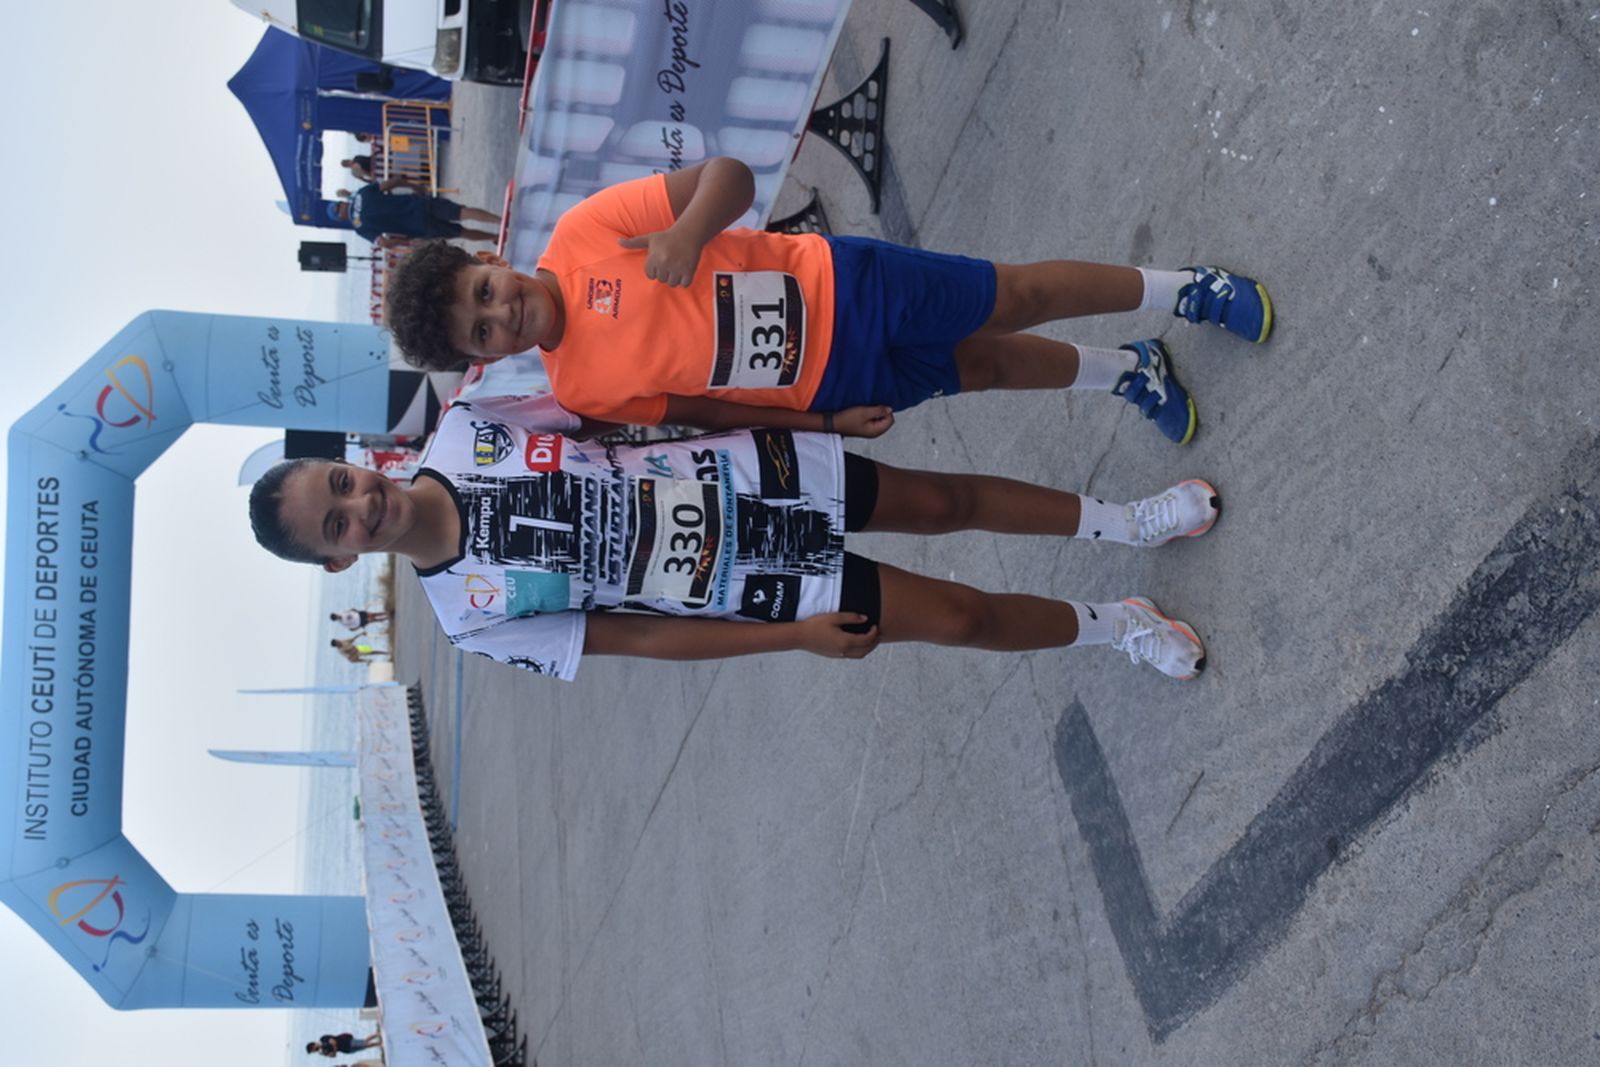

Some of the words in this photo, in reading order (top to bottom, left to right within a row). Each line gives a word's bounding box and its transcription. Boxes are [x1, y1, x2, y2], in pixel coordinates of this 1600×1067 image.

[657, 0, 701, 94] Deporte
[669, 99, 685, 123] es
[652, 127, 684, 174] euta
[586, 277, 595, 310] UNDER
[612, 279, 622, 320] ARMOUR
[266, 326, 280, 341] es
[749, 297, 785, 370] 331
[257, 345, 284, 410] Ceuta
[294, 326, 327, 408] Deporte
[35, 477, 60, 601] DEPORTES
[79, 500, 99, 570] CEUTA
[476, 496, 494, 549] Kempa
[509, 514, 575, 533] 1
[663, 503, 704, 576] 330
[724, 523, 733, 538] DE
[79, 575, 97, 604] DE
[716, 541, 734, 606] MATERIALES
[34, 608, 56, 639] DE
[28, 645, 56, 714] CEUTÍ
[72, 609, 97, 731] AUTÓNOMA
[23, 721, 53, 841] INSTITUTO
[70, 736, 92, 817] CIUDAD
[245, 918, 260, 941] es
[271, 917, 305, 1002] Deporte
[234, 946, 260, 1004] Ceuta
